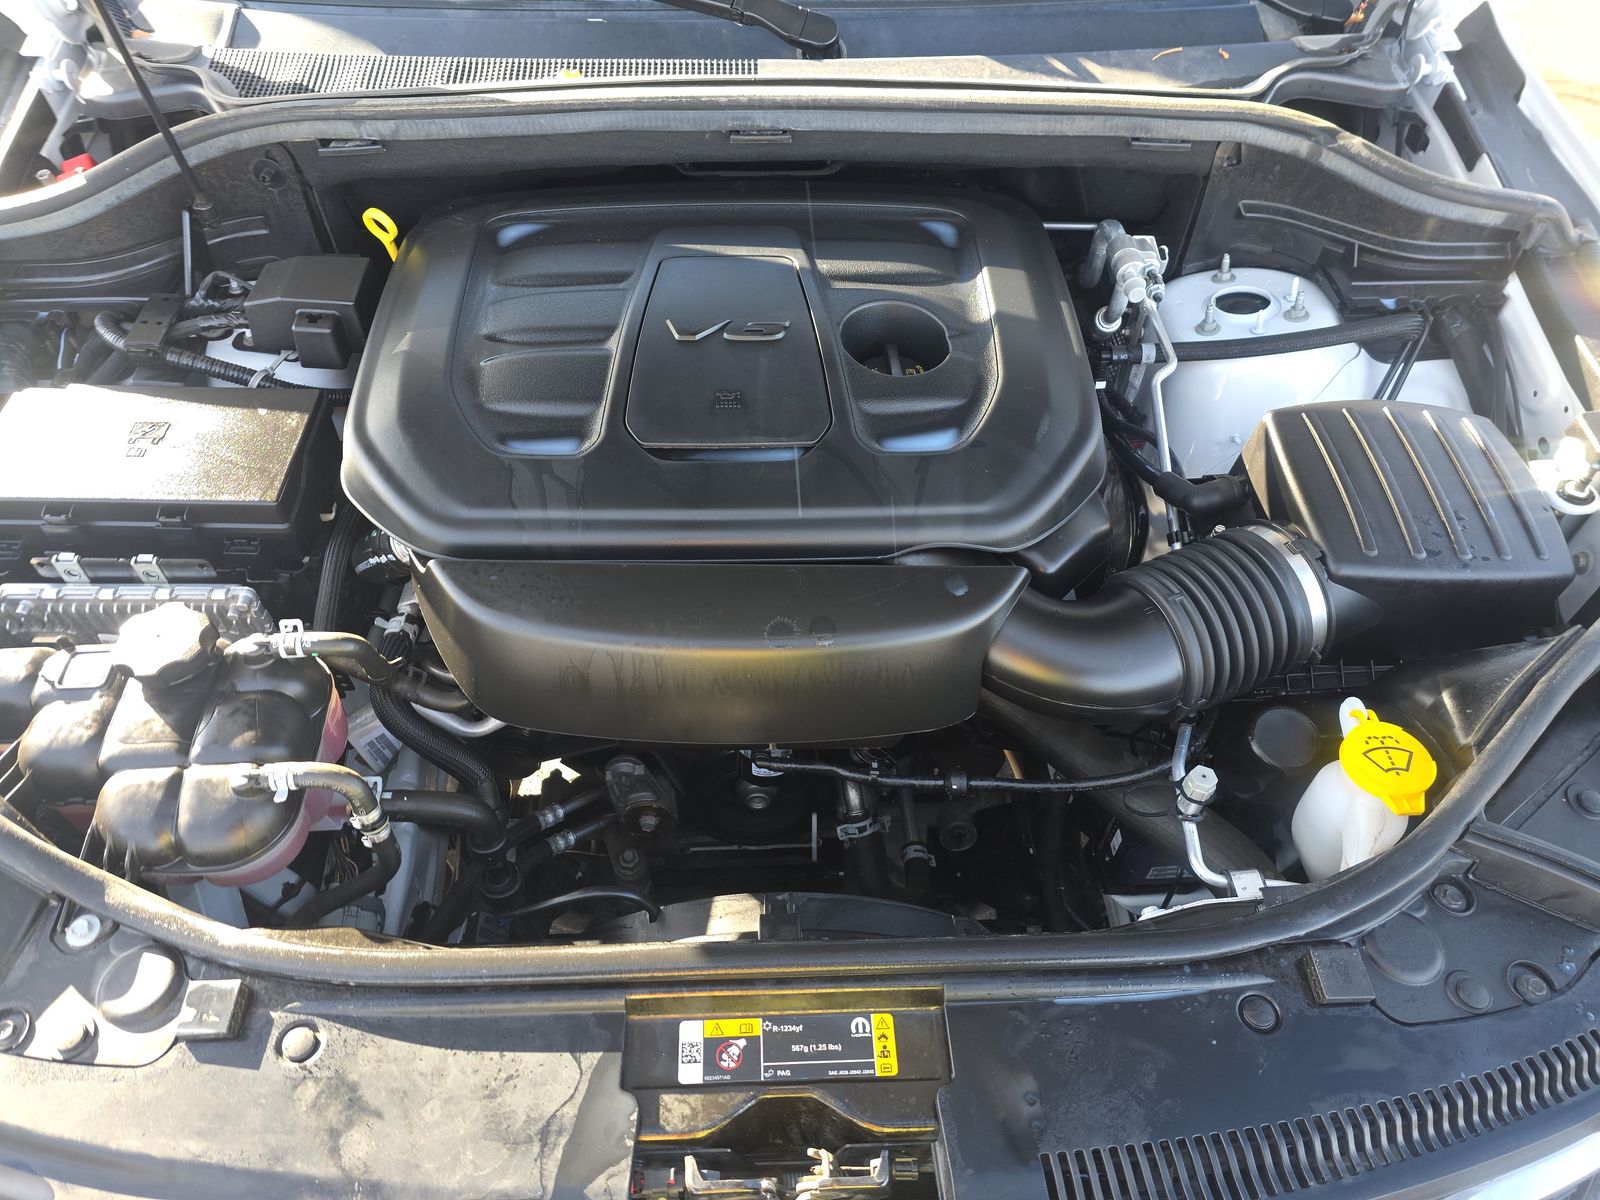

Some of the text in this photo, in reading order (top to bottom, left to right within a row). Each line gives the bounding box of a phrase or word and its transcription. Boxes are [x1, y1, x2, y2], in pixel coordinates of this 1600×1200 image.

[772, 1024, 803, 1033] R-1234yf
[810, 1043, 827, 1051] (1.25
[828, 1043, 842, 1051] lbs)
